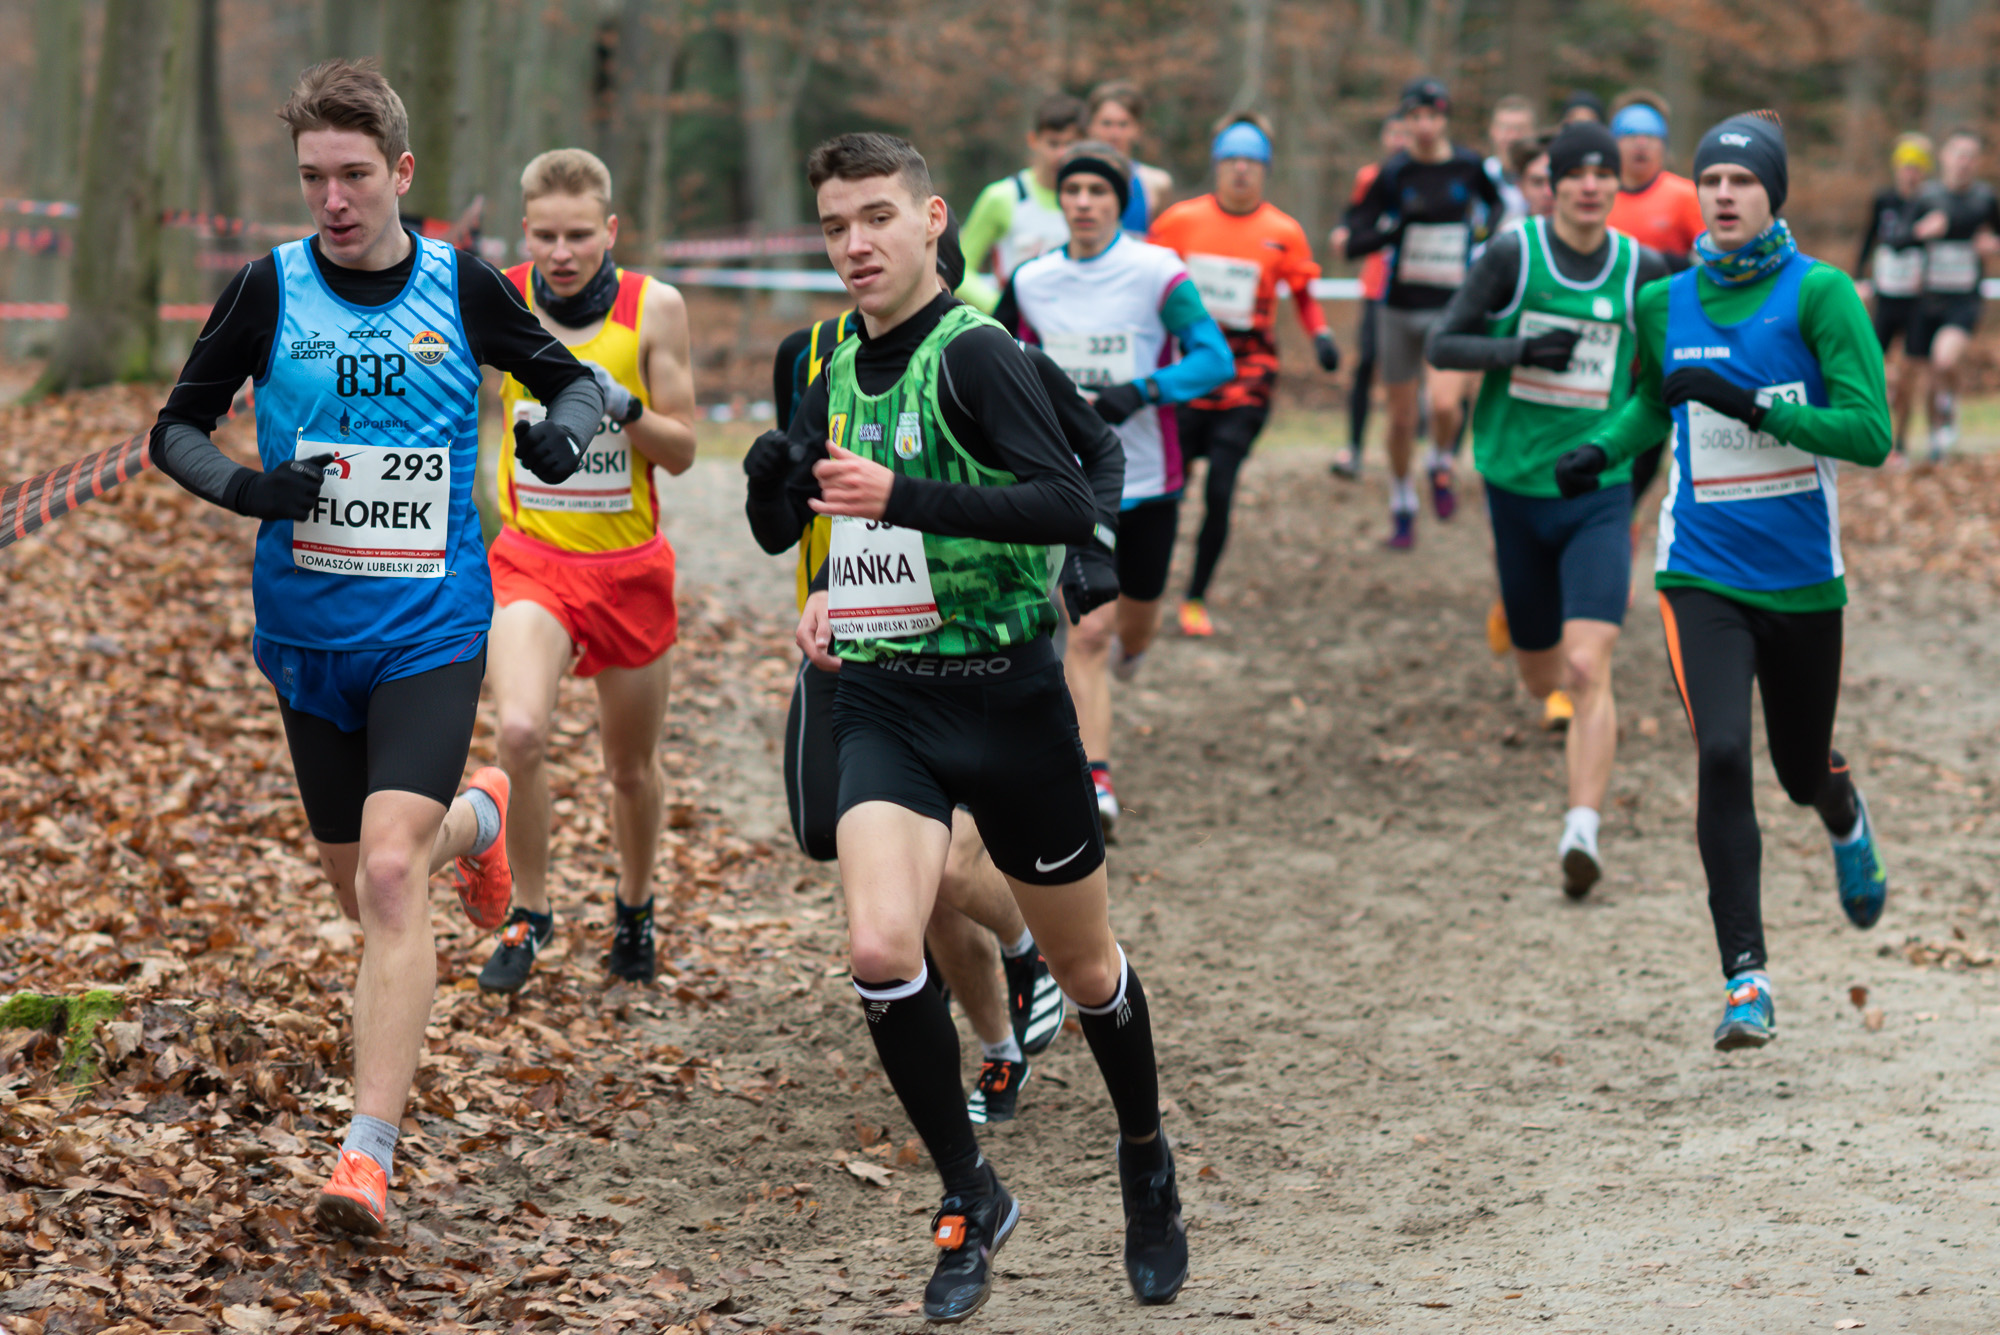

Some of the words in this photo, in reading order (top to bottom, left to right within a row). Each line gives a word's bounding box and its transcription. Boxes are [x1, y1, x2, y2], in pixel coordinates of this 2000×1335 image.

[348, 330, 392, 338] COLO
[291, 350, 335, 359] AZOTY
[1088, 335, 1127, 355] 323
[336, 354, 405, 397] 832
[354, 420, 410, 429] OPOLSKIE
[381, 453, 443, 481] 293
[313, 497, 433, 530] FLOREK
[301, 555, 363, 571] TOMASZÓW
[367, 562, 413, 573] LUBELSKI
[416, 563, 440, 573] 2021
[833, 548, 917, 588] MAŃKA
[867, 620, 909, 633] LUBELSKI
[911, 617, 936, 629] 2021
[940, 657, 1011, 677] PRO
